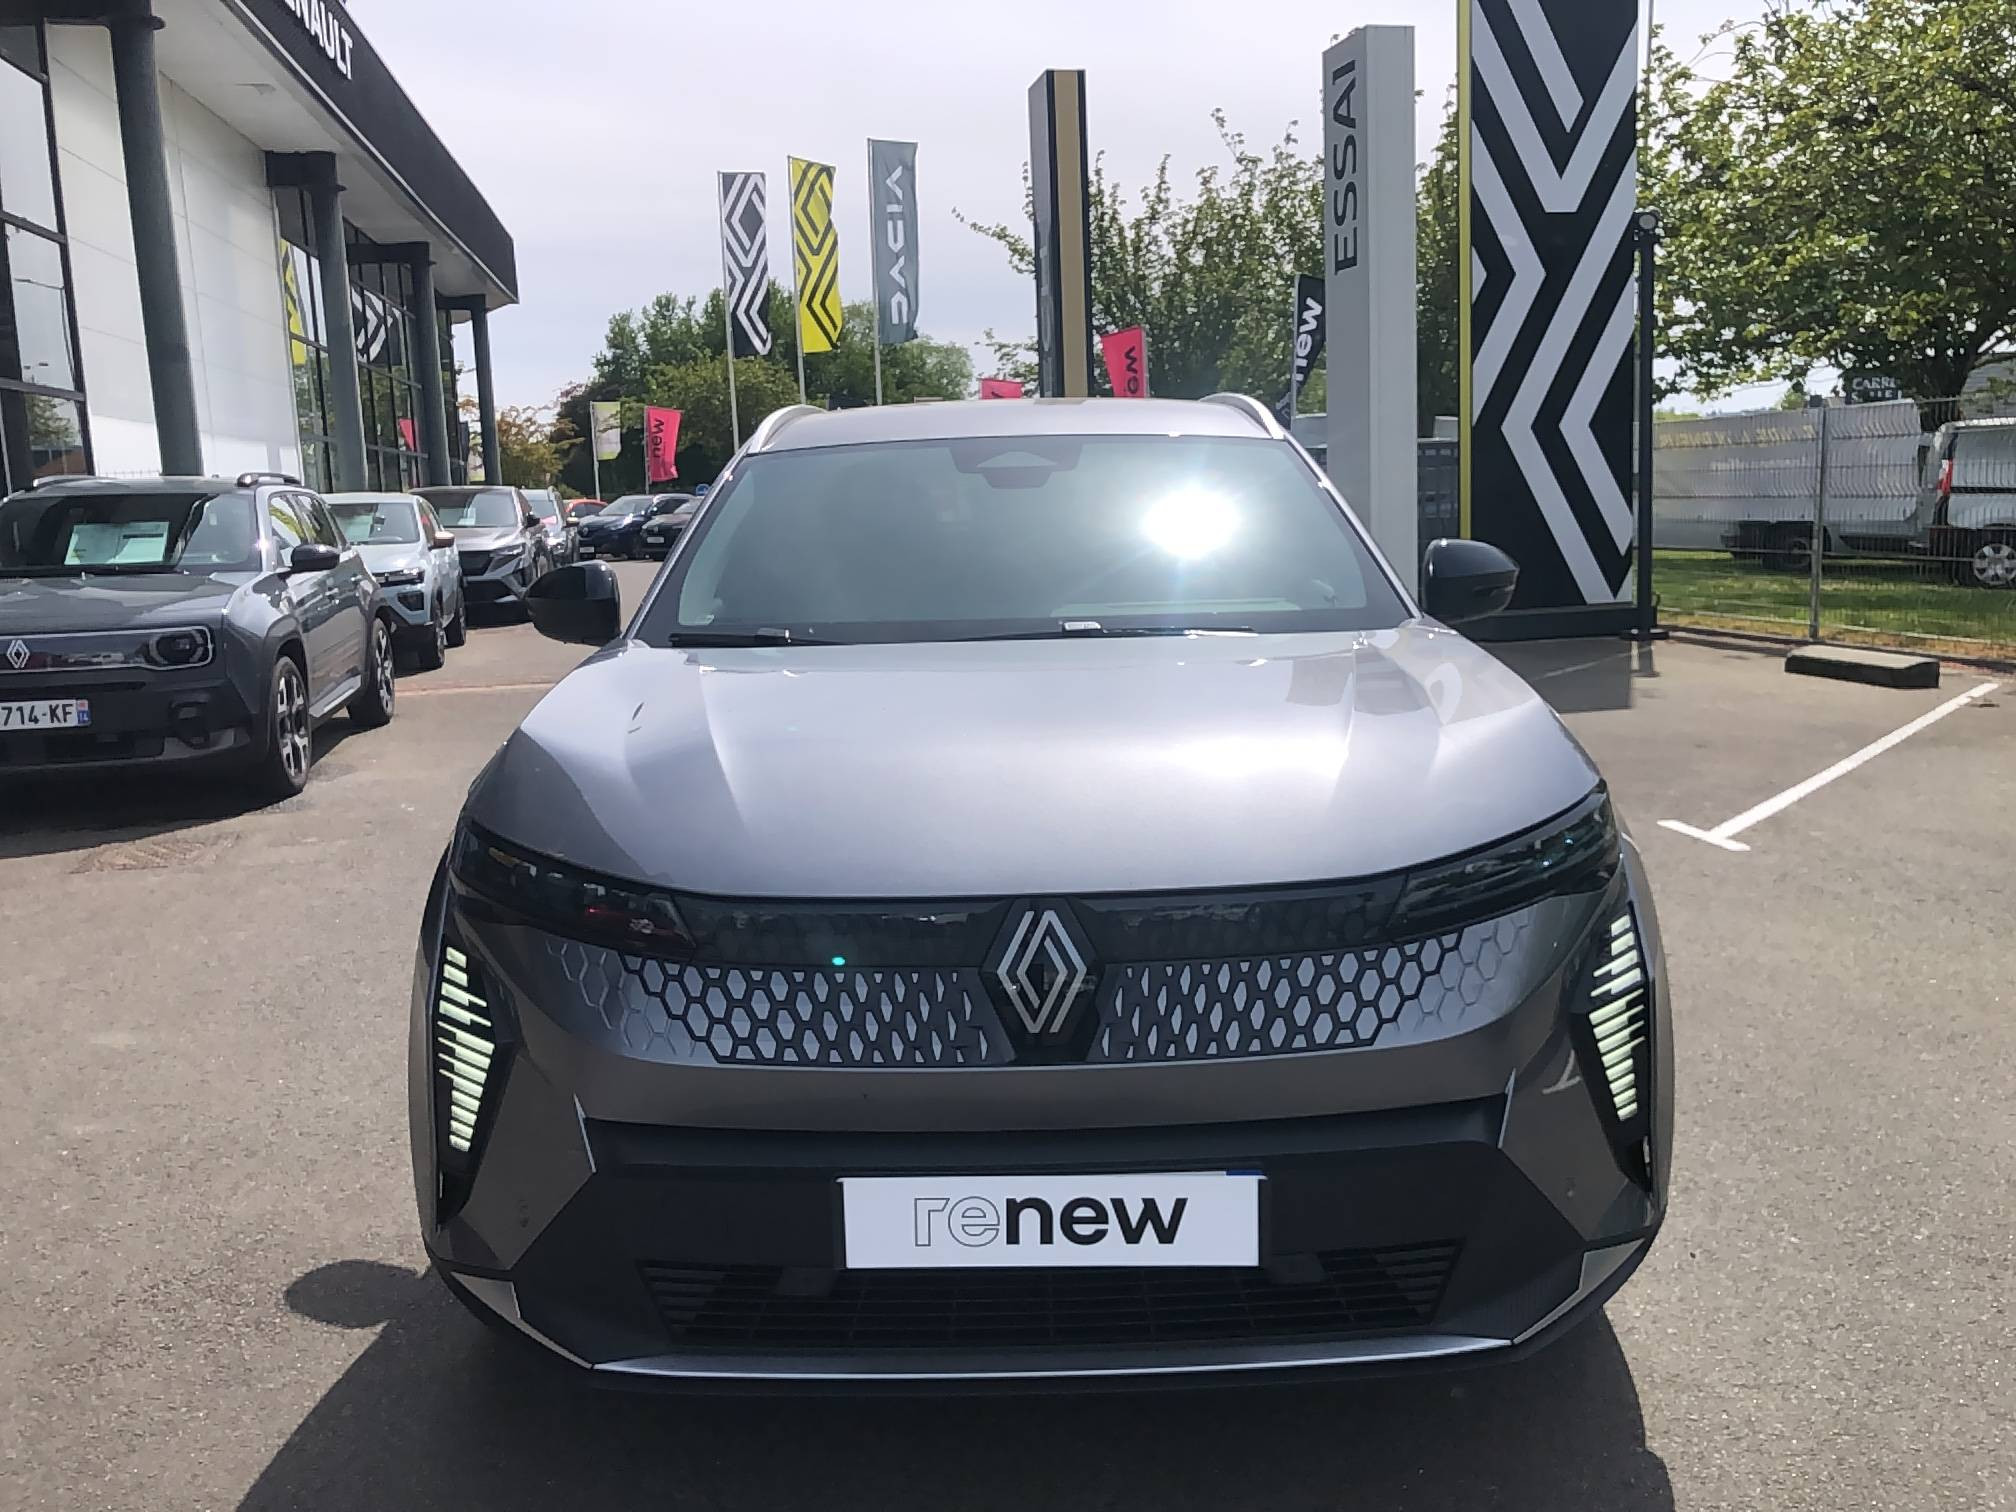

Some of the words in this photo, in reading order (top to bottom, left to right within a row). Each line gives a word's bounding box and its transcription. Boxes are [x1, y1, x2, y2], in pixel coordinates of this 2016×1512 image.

[284, 0, 354, 80] NAULT
[1333, 59, 1358, 276] ESSAI
[885, 165, 909, 325] DACIA
[914, 1196, 1189, 1248] renew
